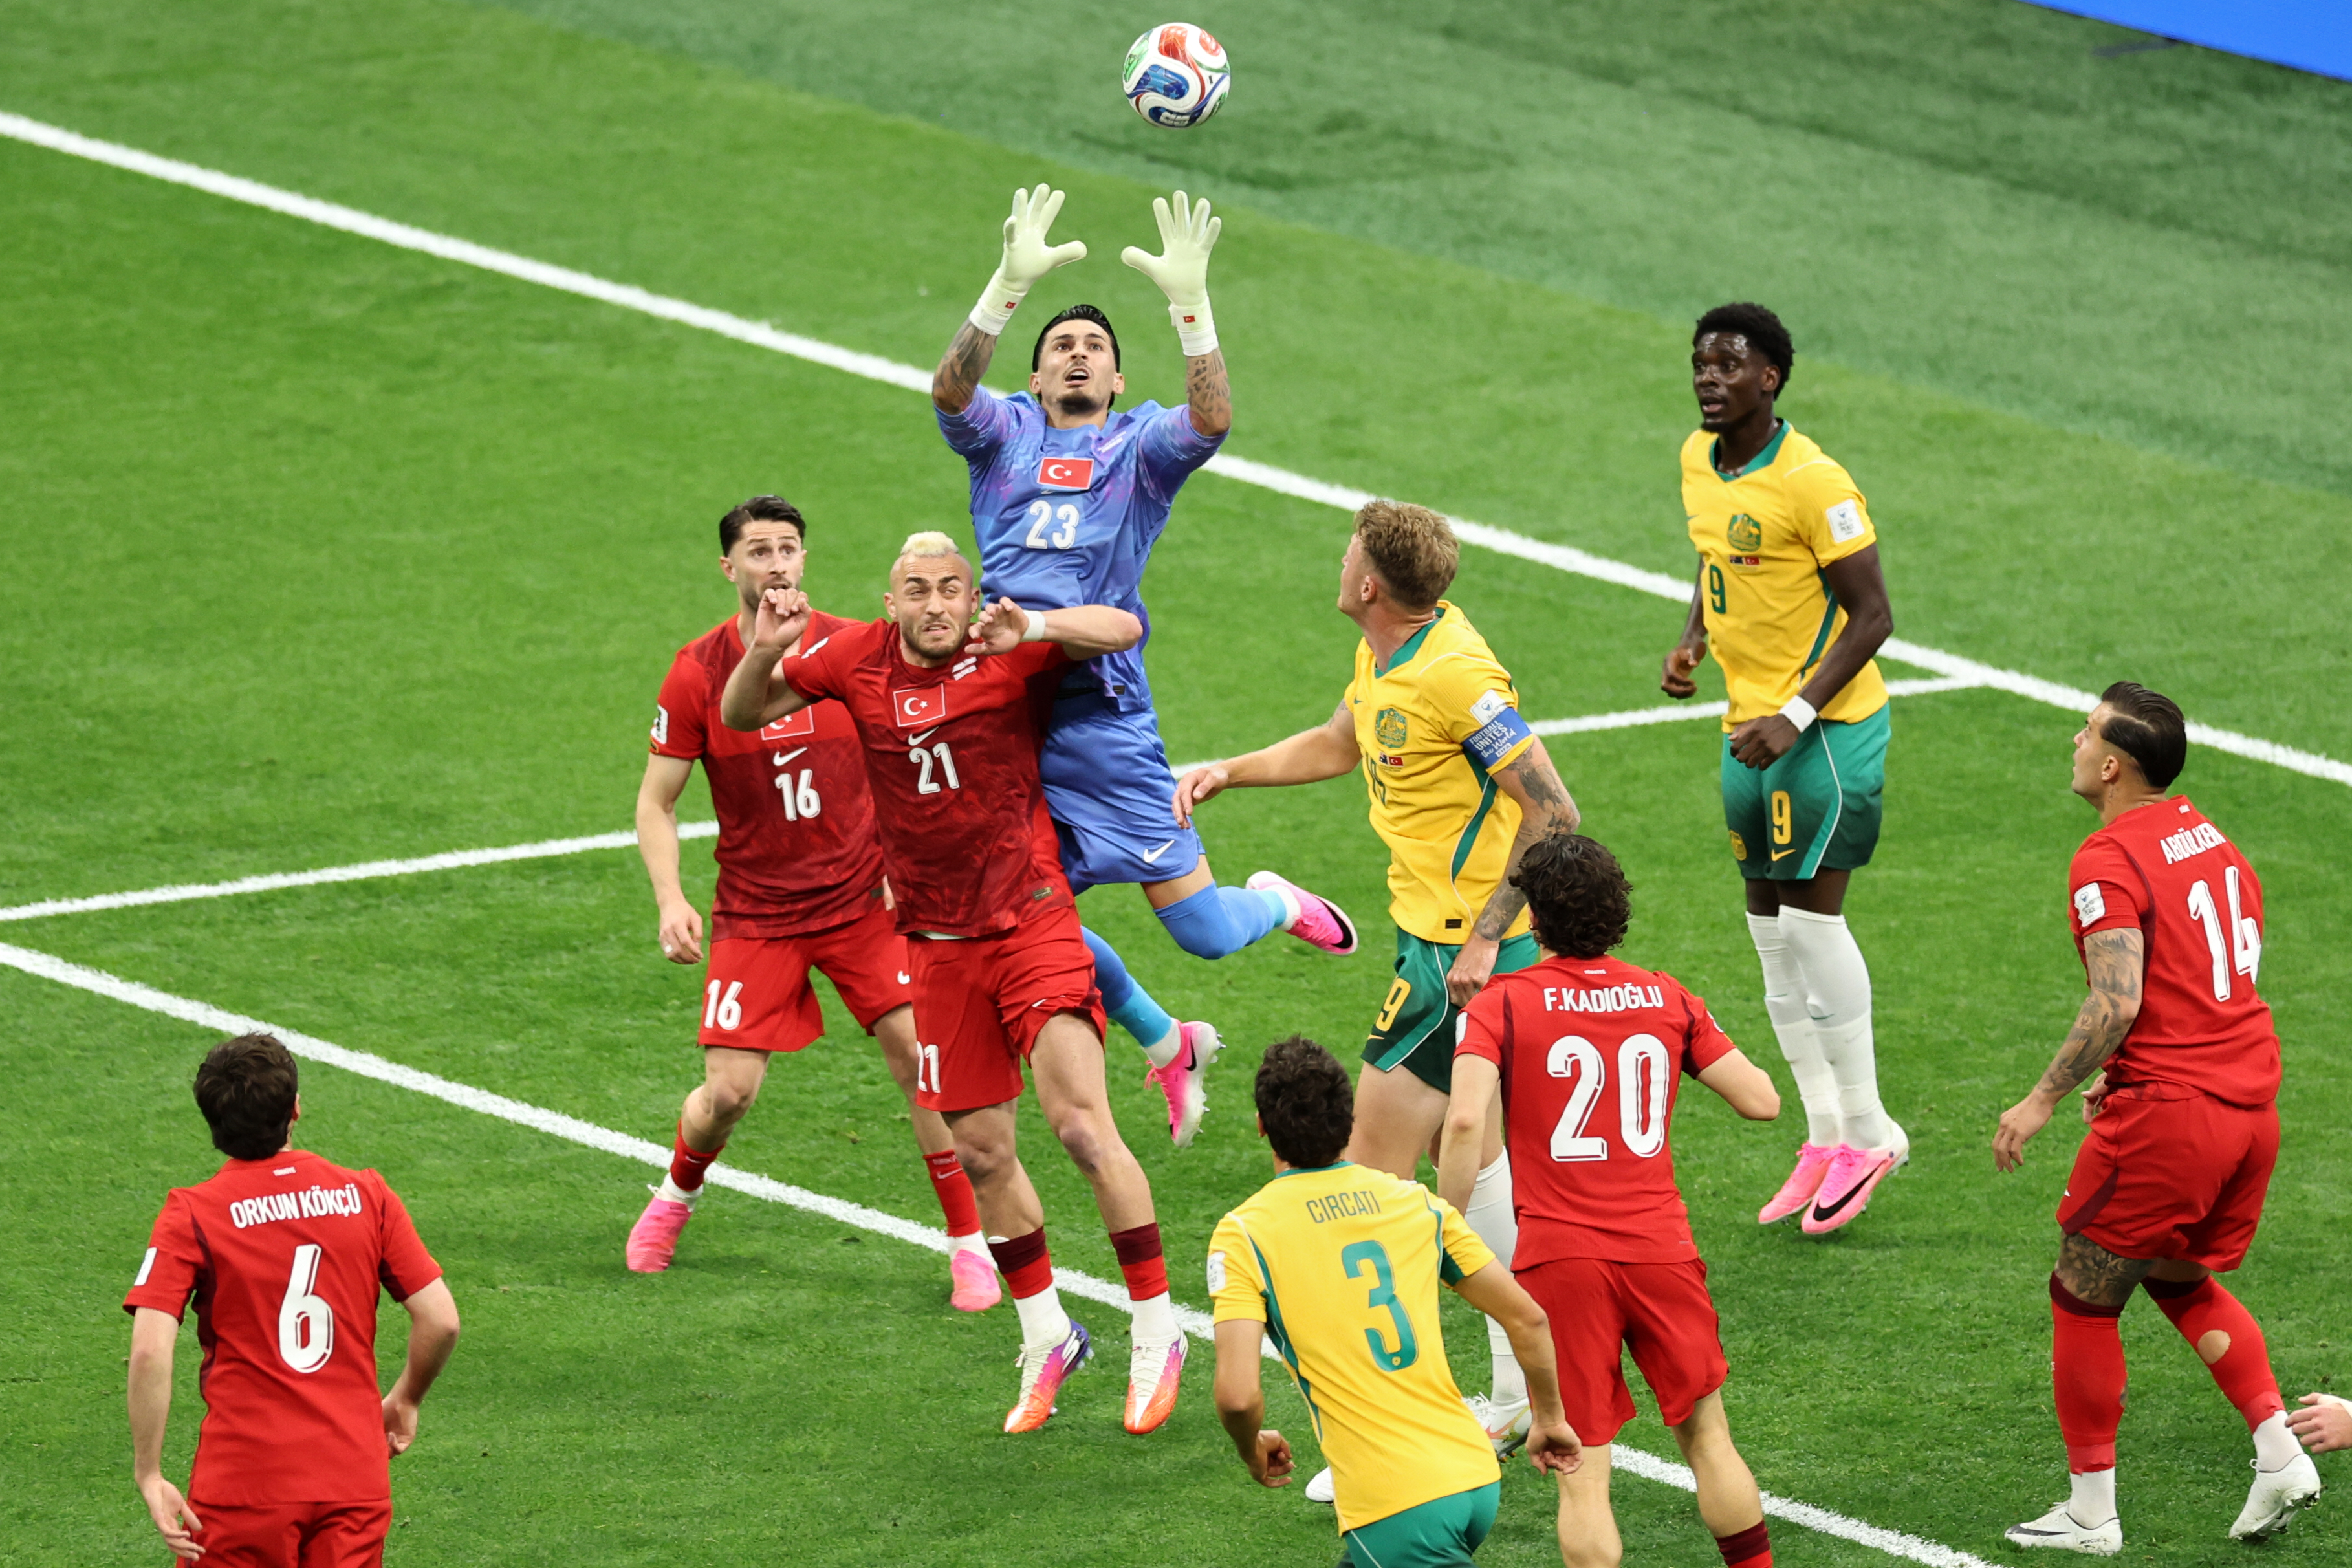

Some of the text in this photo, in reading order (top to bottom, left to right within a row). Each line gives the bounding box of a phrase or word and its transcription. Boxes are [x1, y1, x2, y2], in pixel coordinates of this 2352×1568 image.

[1025, 499, 1080, 550] 23
[1709, 563, 1726, 615] 9
[1468, 720, 1501, 745] FOOTBALL
[1474, 724, 1508, 751] UNITES
[908, 741, 961, 795] 21
[774, 768, 821, 822] 16
[1771, 790, 1792, 845] 9
[2187, 865, 2262, 1003] 14
[704, 979, 744, 1030] 16
[1543, 982, 1665, 1013] F.KADIOĞLU
[1546, 1032, 1670, 1162] 20
[229, 1183, 362, 1229] ORKUN KÖKÇÜ
[1305, 1190, 1382, 1224] CIRCATI
[278, 1243, 334, 1374] 6
[1341, 1239, 1419, 1373] 3
